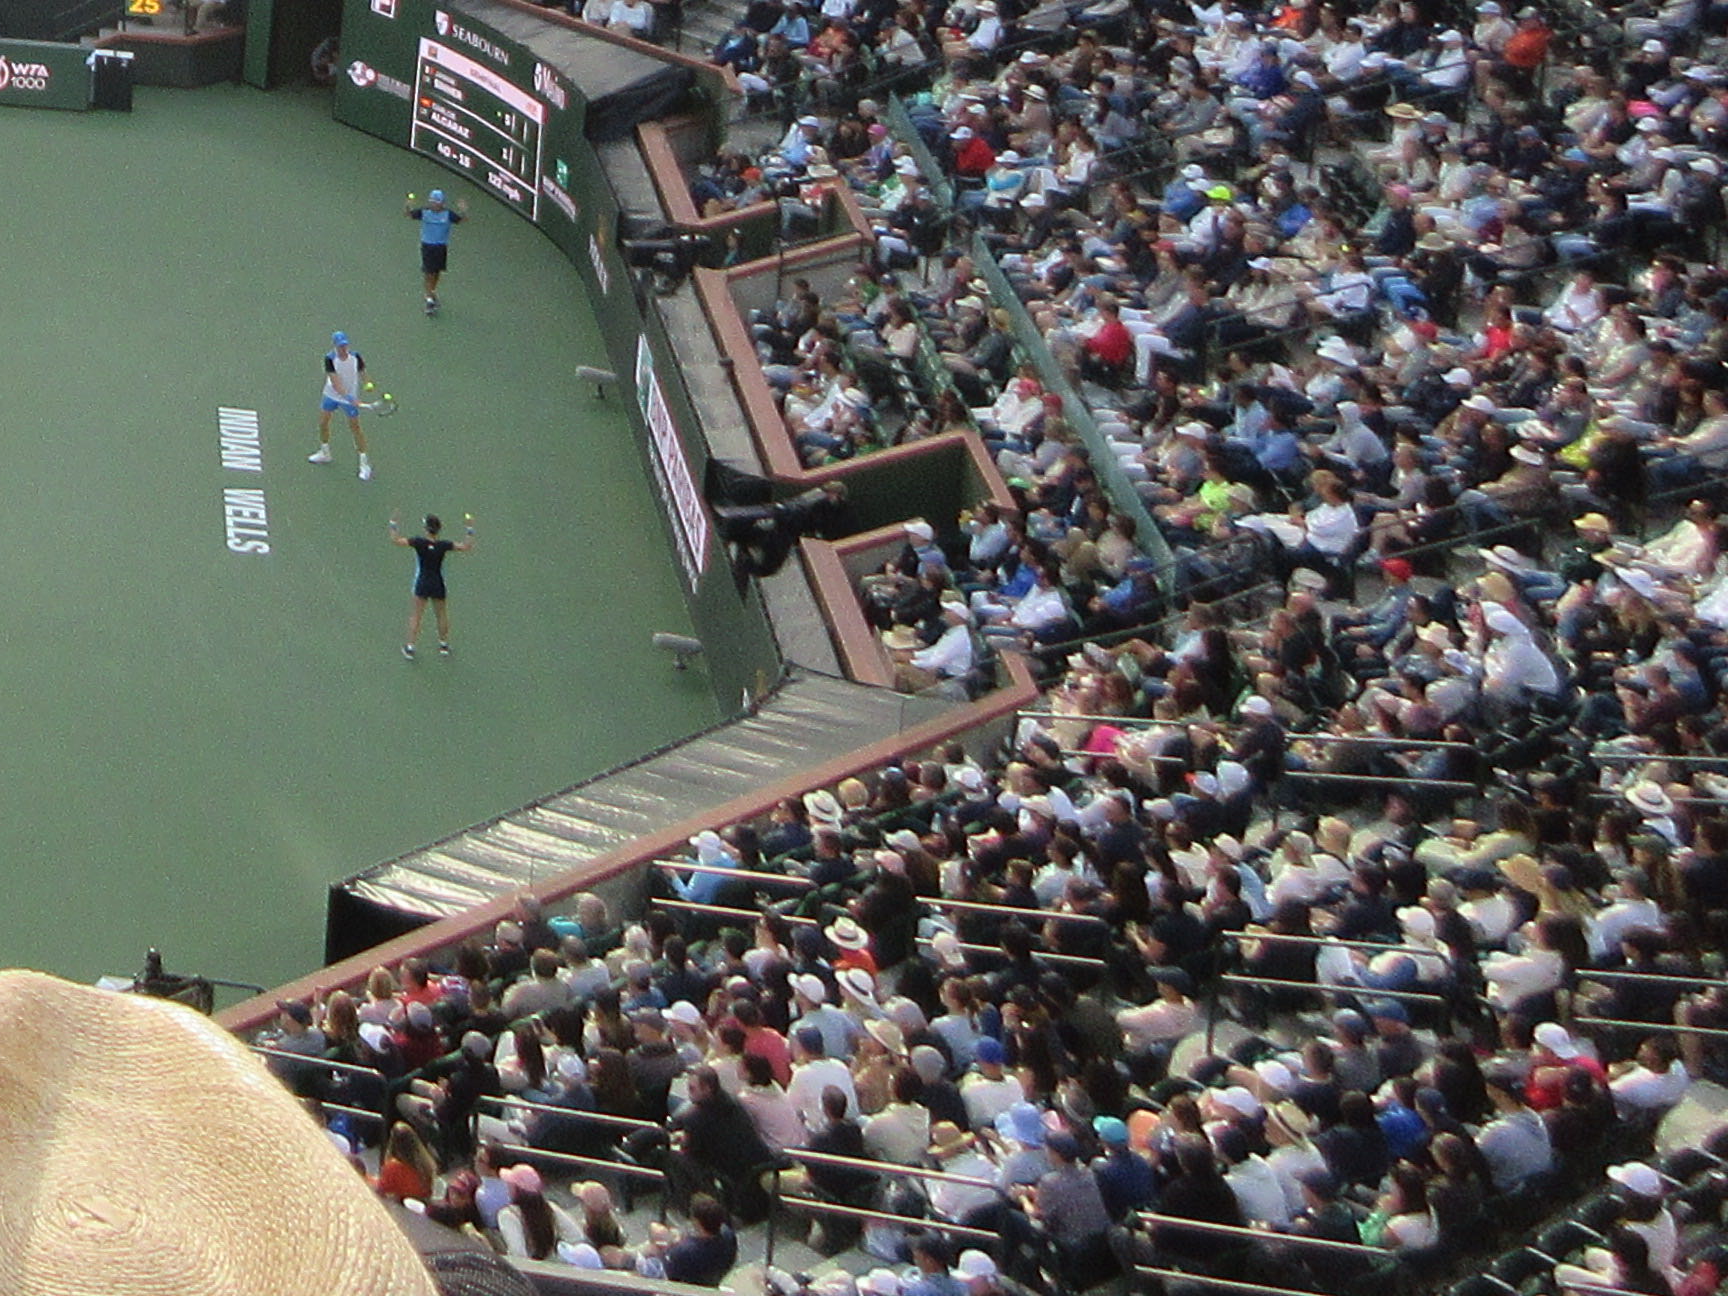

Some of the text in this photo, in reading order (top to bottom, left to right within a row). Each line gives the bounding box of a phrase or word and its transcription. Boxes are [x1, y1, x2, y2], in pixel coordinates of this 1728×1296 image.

[452, 23, 511, 67] SEABOURN
[11, 62, 50, 78] WTA
[11, 76, 47, 90] 1000
[431, 111, 470, 139] ALCARAZ
[217, 406, 271, 554] INDIAN WELLS
